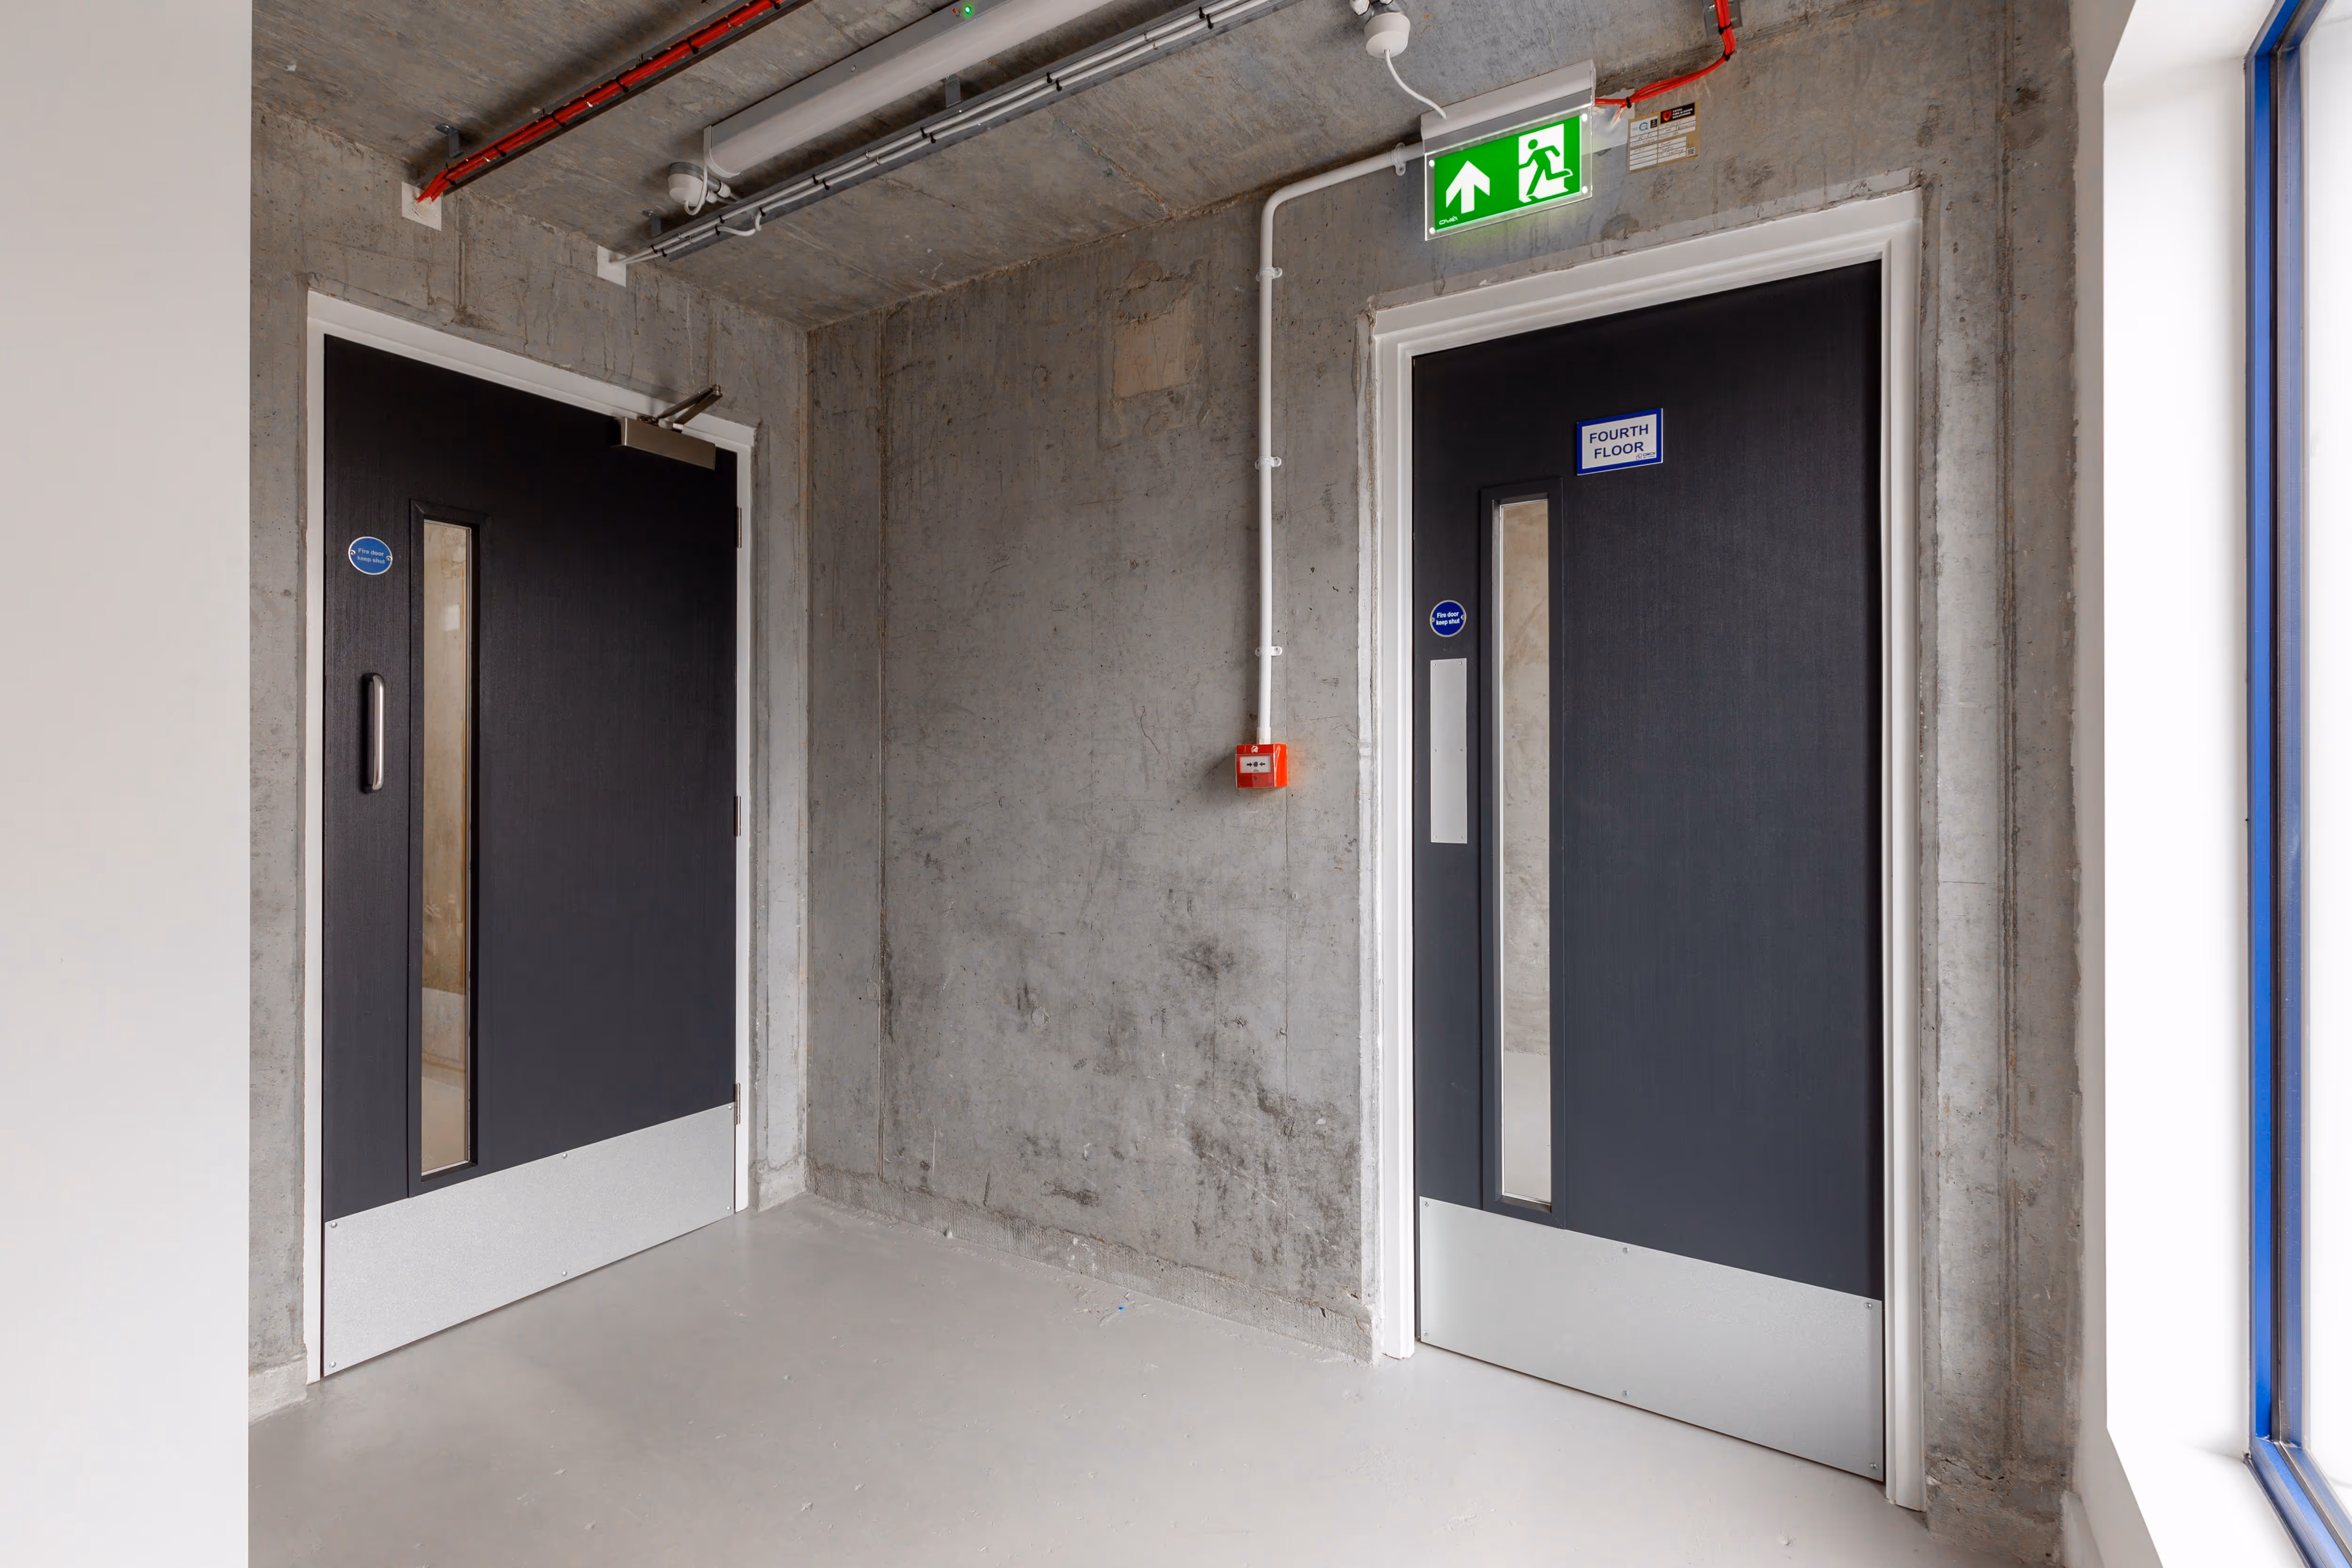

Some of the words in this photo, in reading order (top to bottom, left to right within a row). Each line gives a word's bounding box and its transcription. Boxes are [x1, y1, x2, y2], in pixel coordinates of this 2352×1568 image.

[1438, 215, 1458, 225] OVIA
[1589, 423, 1649, 444] FOURTH
[1594, 441, 1644, 459] FLOOR
